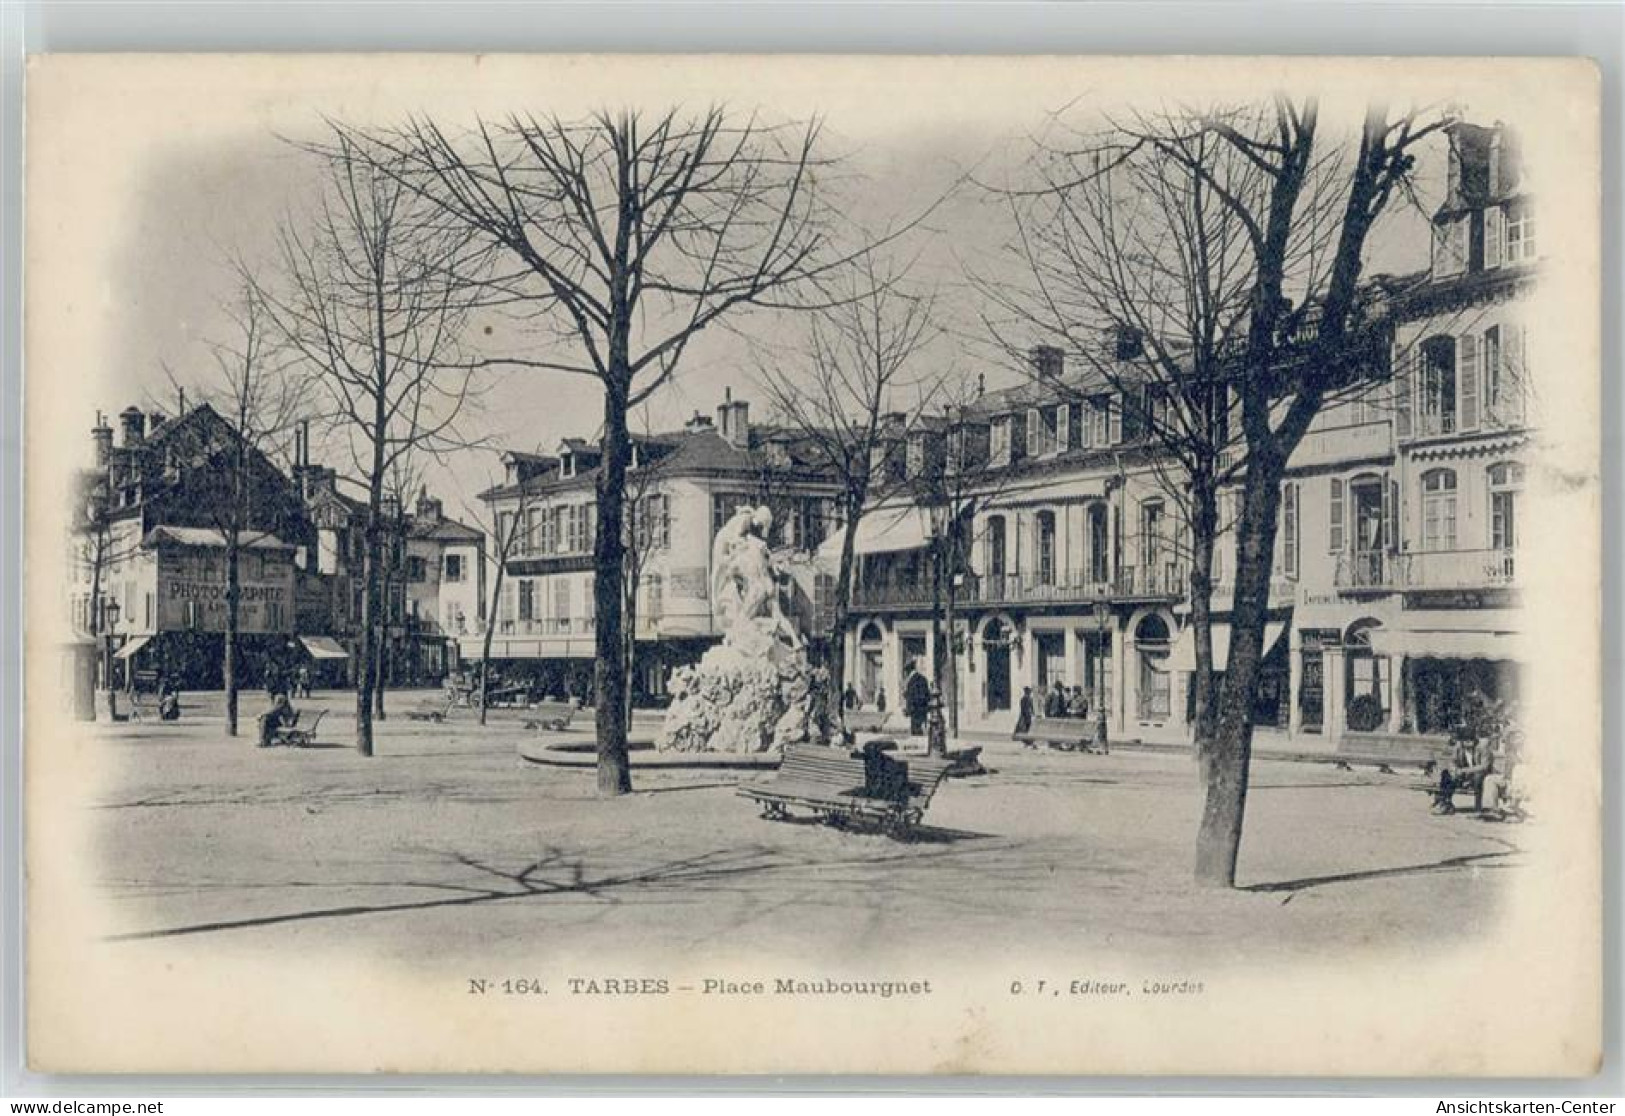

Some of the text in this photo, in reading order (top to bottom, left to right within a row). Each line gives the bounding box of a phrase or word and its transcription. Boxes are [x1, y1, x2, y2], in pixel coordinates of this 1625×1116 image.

[501, 978, 549, 995] 164.
[567, 978, 670, 995] TARBES
[701, 978, 765, 995] Place
[773, 978, 933, 998] Maubourgnet
